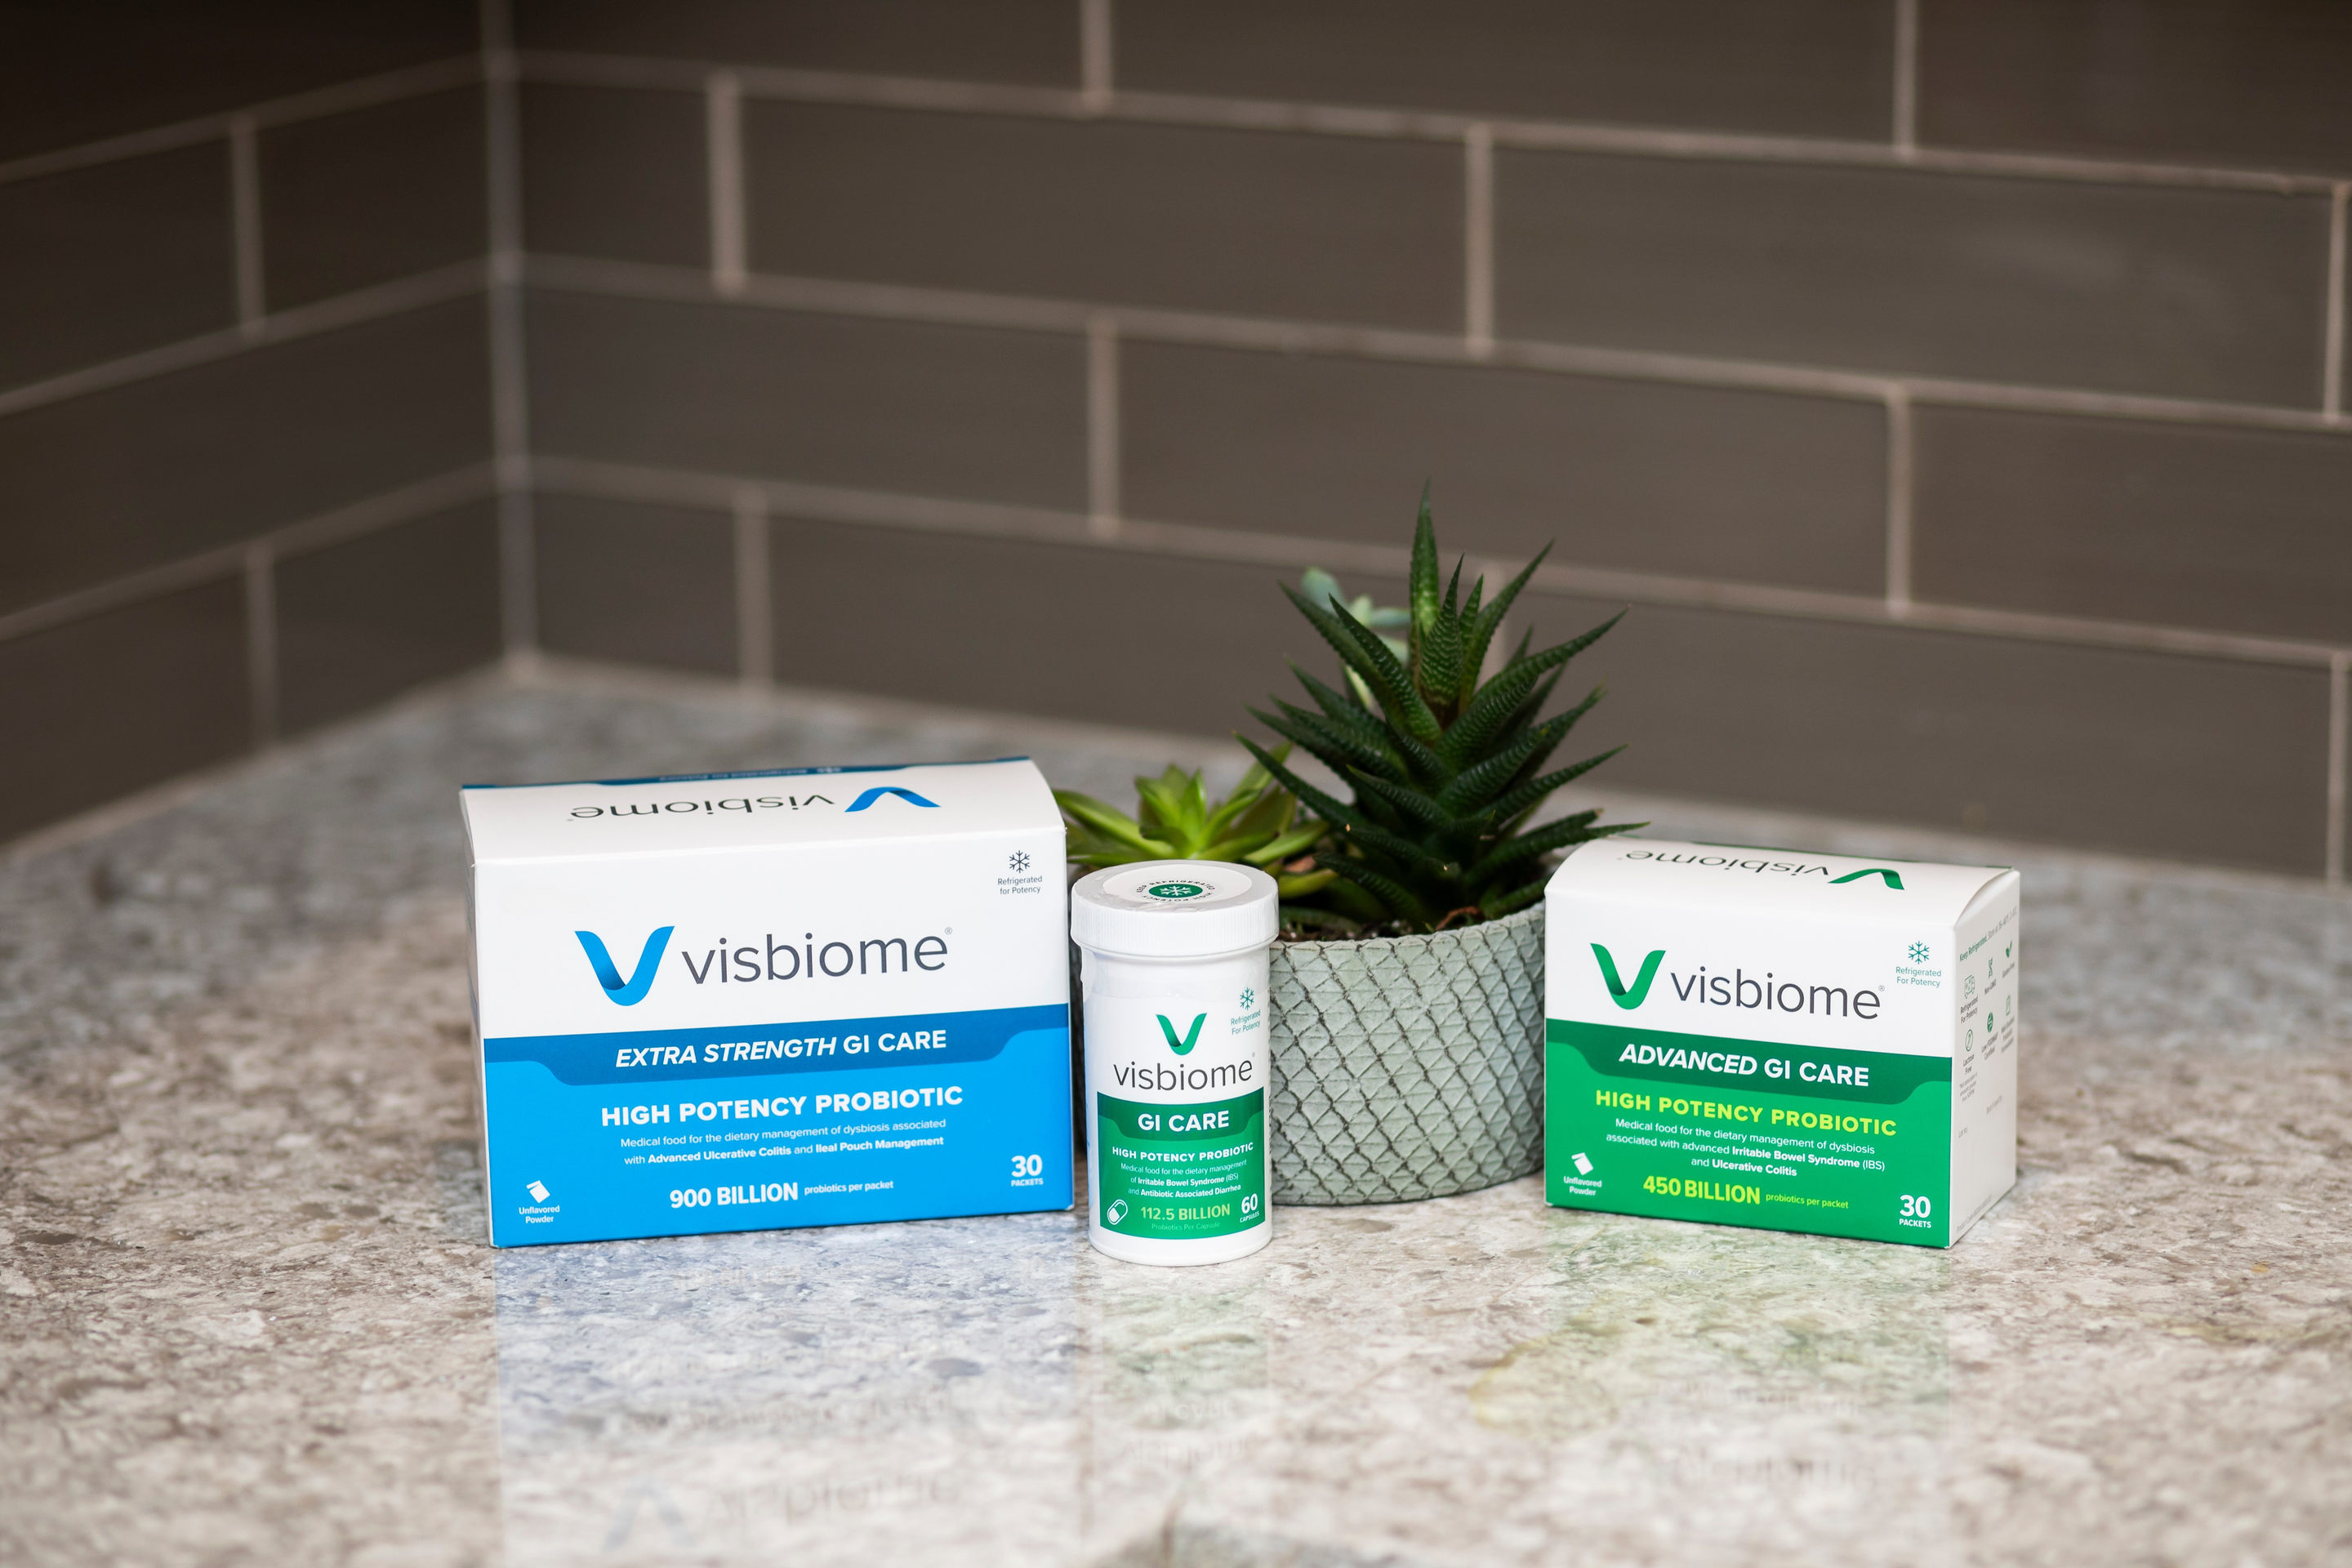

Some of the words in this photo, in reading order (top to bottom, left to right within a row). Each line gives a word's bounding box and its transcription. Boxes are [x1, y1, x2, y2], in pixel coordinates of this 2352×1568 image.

[571, 792, 836, 819] visbiome
[1625, 849, 1829, 878] visbiome
[997, 875, 1042, 889] Refrigerated
[1000, 887, 1011, 896] for
[1013, 883, 1041, 896] Potency
[681, 932, 948, 985] visbiome
[1895, 966, 1941, 978] Refrigerated
[1896, 976, 1909, 985] For
[1910, 978, 1940, 988] Potency
[1670, 966, 1880, 1020] visbiome
[1961, 995, 1978, 1014] Refrigerated
[1967, 1007, 1978, 1020] Potency
[1231, 1009, 1261, 1025] Refrigerated
[1232, 1027, 1241, 1035] For
[1242, 1020, 1261, 1032] Potency
[615, 1046, 697, 1068] EXTRA
[703, 1037, 837, 1062] STRENGTH
[843, 1035, 870, 1054] GI
[875, 1030, 947, 1052] CARE
[1619, 1044, 1757, 1076] ADVANCED
[1764, 1059, 1790, 1080] GI
[1798, 1062, 1869, 1087] CARE
[1963, 1054, 1975, 1067] Lactose
[1113, 1059, 1253, 1091] visbiome
[601, 1103, 670, 1127] HIGH
[679, 1096, 806, 1123] POTENCY
[816, 1085, 964, 1115] PROBIOTIC
[1595, 1089, 1651, 1111] HIGH
[1659, 1095, 1764, 1124] POTENCY
[1771, 1107, 1897, 1137] PROBIOTIC
[1138, 1114, 1160, 1132] GI
[1168, 1110, 1229, 1132] CARE
[621, 1137, 660, 1147] Medical
[663, 1135, 686, 1145] food
[689, 1134, 702, 1143] for
[706, 1134, 722, 1143] the
[724, 1131, 759, 1142] dietary
[762, 1126, 828, 1140] management
[831, 1125, 841, 1134] of
[844, 1123, 889, 1136] dysbiosis
[893, 1119, 946, 1131] associated
[1615, 1118, 1653, 1131] Medical
[1655, 1121, 1677, 1134] food
[1679, 1124, 1694, 1135] for
[1695, 1126, 1712, 1138] the
[1713, 1128, 1747, 1143] dietary
[1749, 1134, 1815, 1148] management
[1816, 1139, 1827, 1150] of
[1829, 1141, 1875, 1154] dysbiosis
[625, 1155, 645, 1165] with
[648, 1152, 701, 1164] Advanced
[703, 1148, 756, 1160] Ulcerative
[759, 1146, 791, 1156] Colitis
[794, 1144, 813, 1154] and
[816, 1143, 837, 1153] Ileal
[840, 1140, 872, 1152] Pouch
[875, 1137, 944, 1150] Management
[1112, 1147, 1137, 1160] HIGH
[1140, 1152, 1196, 1162] POTENCY
[1199, 1142, 1254, 1160] PROBIOTIC
[1606, 1133, 1657, 1147] associated
[1659, 1138, 1680, 1149] with
[1682, 1141, 1730, 1154] advanced
[1731, 1146, 1771, 1159] Irritable
[1774, 1150, 1806, 1162] Bowel
[1807, 1153, 1860, 1169] Syndrome
[1863, 1160, 1885, 1172] (IBS)
[1011, 1154, 1044, 1177] 30
[1120, 1162, 1143, 1173] Medical
[1145, 1166, 1160, 1174] food
[1161, 1167, 1171, 1175] for
[1185, 1165, 1208, 1175] dietary
[1209, 1159, 1247, 1173] management
[1691, 1156, 1709, 1167] and
[1712, 1159, 1763, 1173] Ulcerative
[1766, 1165, 1797, 1176] Colitis
[1010, 1178, 1044, 1187] PACKETS
[1138, 1177, 1165, 1187] Irritable
[1166, 1178, 1189, 1187] Bowel
[1190, 1176, 1225, 1187] Syndrome
[1226, 1173, 1239, 1183] (IBS)
[1563, 1175, 1602, 1187] Unflavored
[670, 1187, 711, 1209] 900
[717, 1182, 799, 1206] BILLION
[804, 1183, 846, 1196] probiotics
[848, 1183, 863, 1193] per
[865, 1180, 893, 1192] packet
[1141, 1189, 1174, 1198] Antibiotic
[1175, 1187, 1214, 1198] Associated
[1214, 1184, 1241, 1195] Diarrhea
[1569, 1185, 1597, 1196] Powder
[1643, 1175, 1682, 1196] 450
[1684, 1180, 1761, 1205] BILLION
[1766, 1192, 1805, 1205] probiotics
[1806, 1196, 1820, 1207] per
[1821, 1198, 1849, 1209] packet
[519, 1204, 560, 1215] Unflavored
[1141, 1206, 1175, 1221] 112.5
[1178, 1203, 1231, 1221] BILLION
[1241, 1193, 1258, 1214] 60
[1900, 1195, 1931, 1218] 30
[525, 1214, 554, 1224] Powder
[1152, 1223, 1183, 1231] Probiotics
[1196, 1221, 1221, 1231] Capsule
[1239, 1210, 1260, 1223] CAPSULES
[1899, 1218, 1932, 1228] PACKETS
